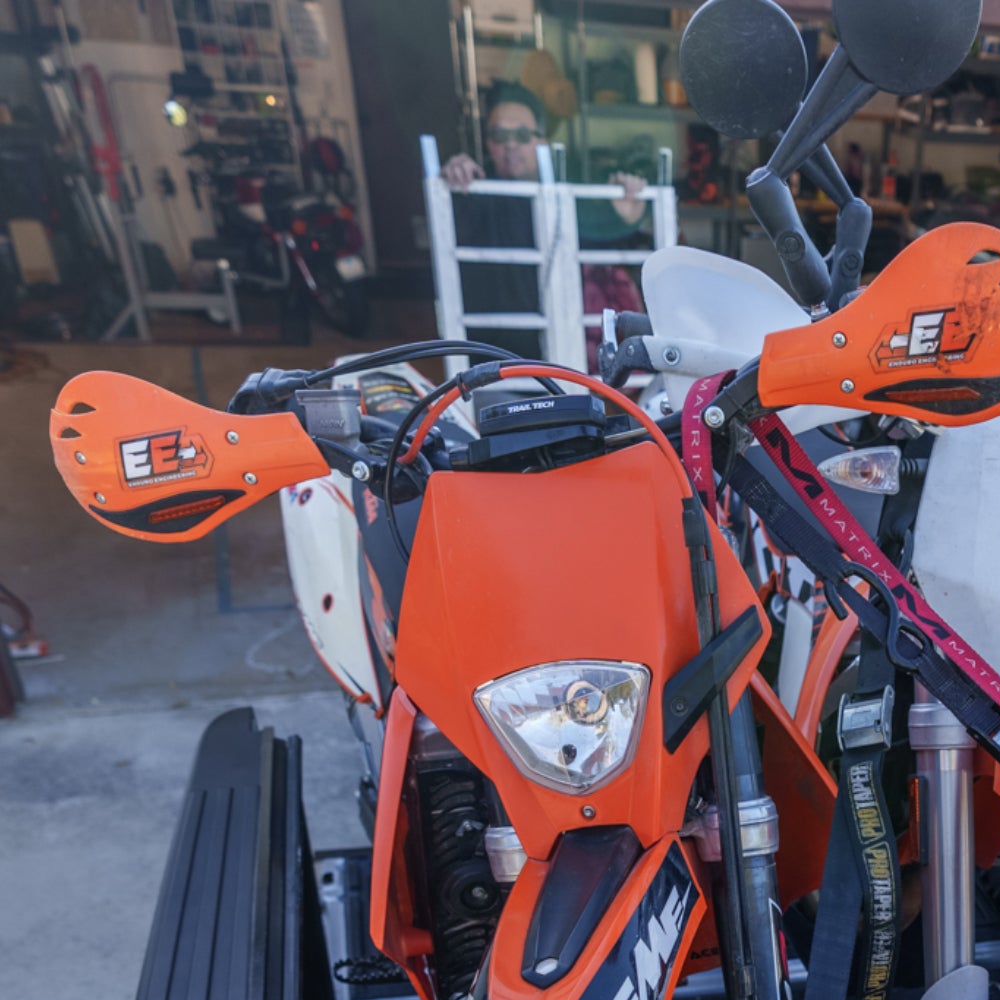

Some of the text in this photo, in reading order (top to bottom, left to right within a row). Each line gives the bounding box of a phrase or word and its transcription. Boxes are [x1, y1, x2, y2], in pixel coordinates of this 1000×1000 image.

[507, 400, 555, 414] TRAIL TECH
[691, 377, 712, 482] MATRIX
[820, 498, 892, 583] MATRIX
